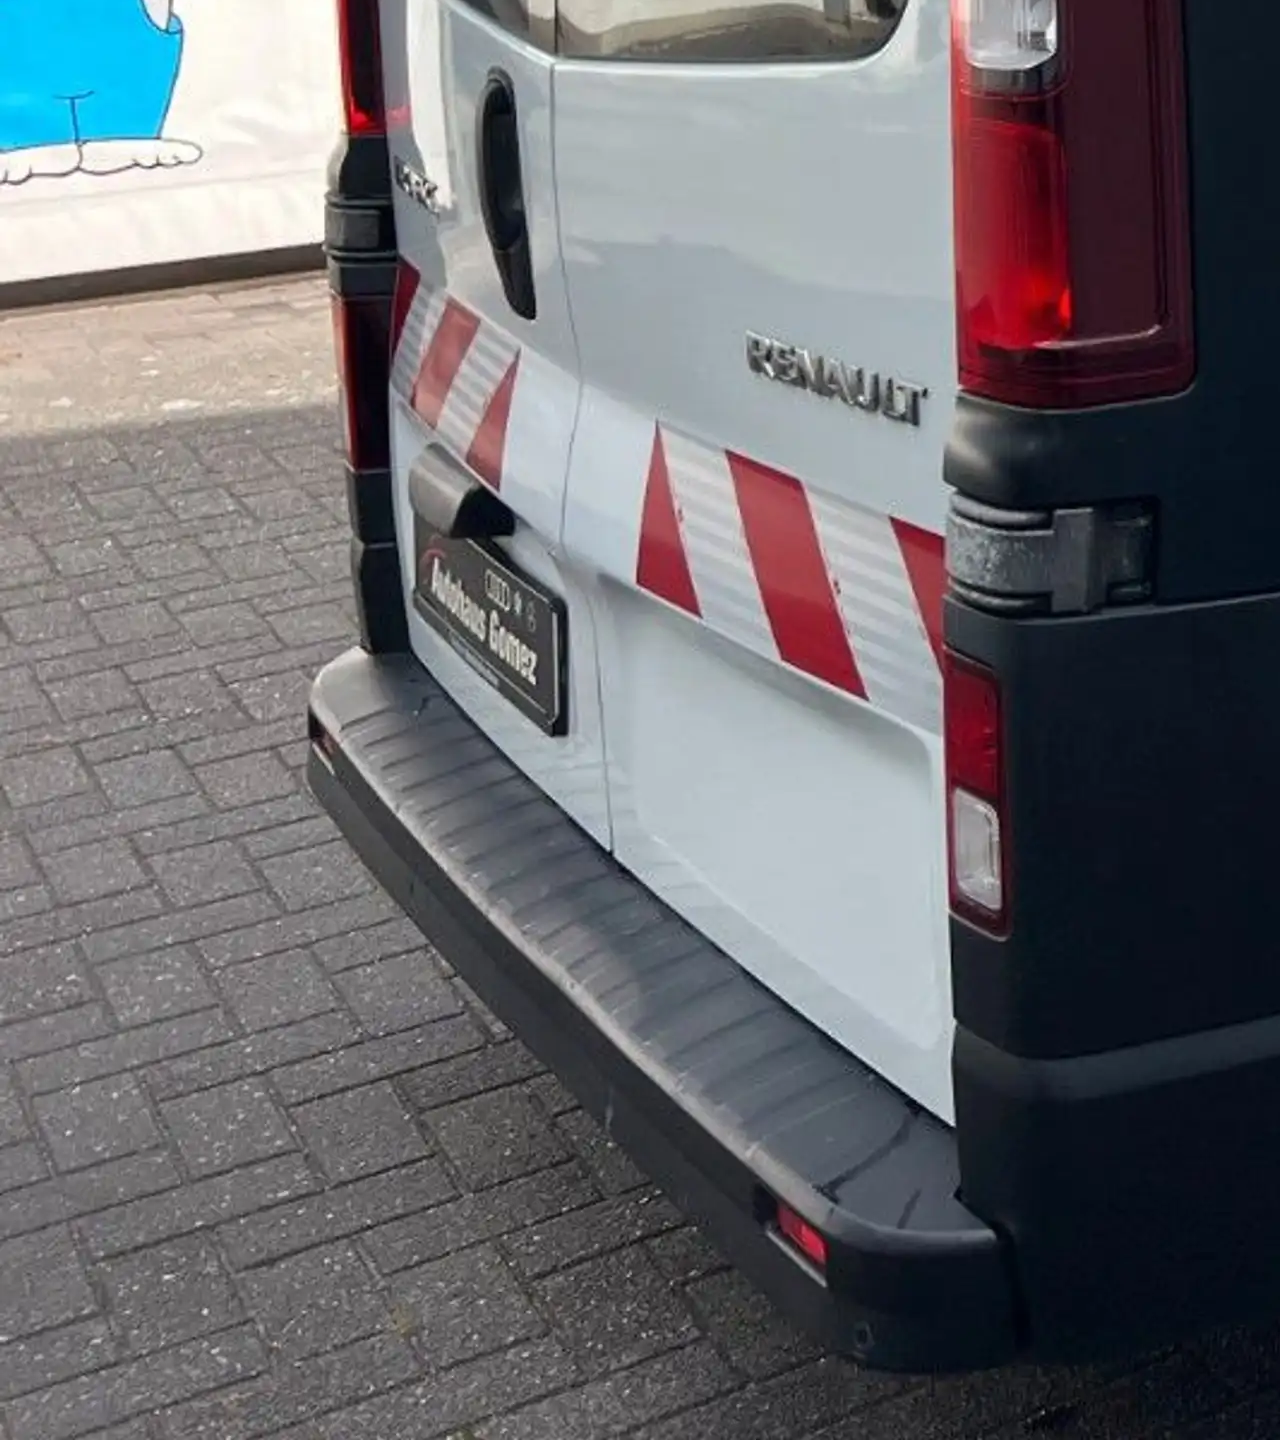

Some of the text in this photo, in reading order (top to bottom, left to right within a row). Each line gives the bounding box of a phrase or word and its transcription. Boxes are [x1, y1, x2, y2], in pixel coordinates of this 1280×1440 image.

[746, 330, 928, 427] RENAULT
[431, 556, 486, 642] Autohaus
[489, 609, 537, 686] Gomez
